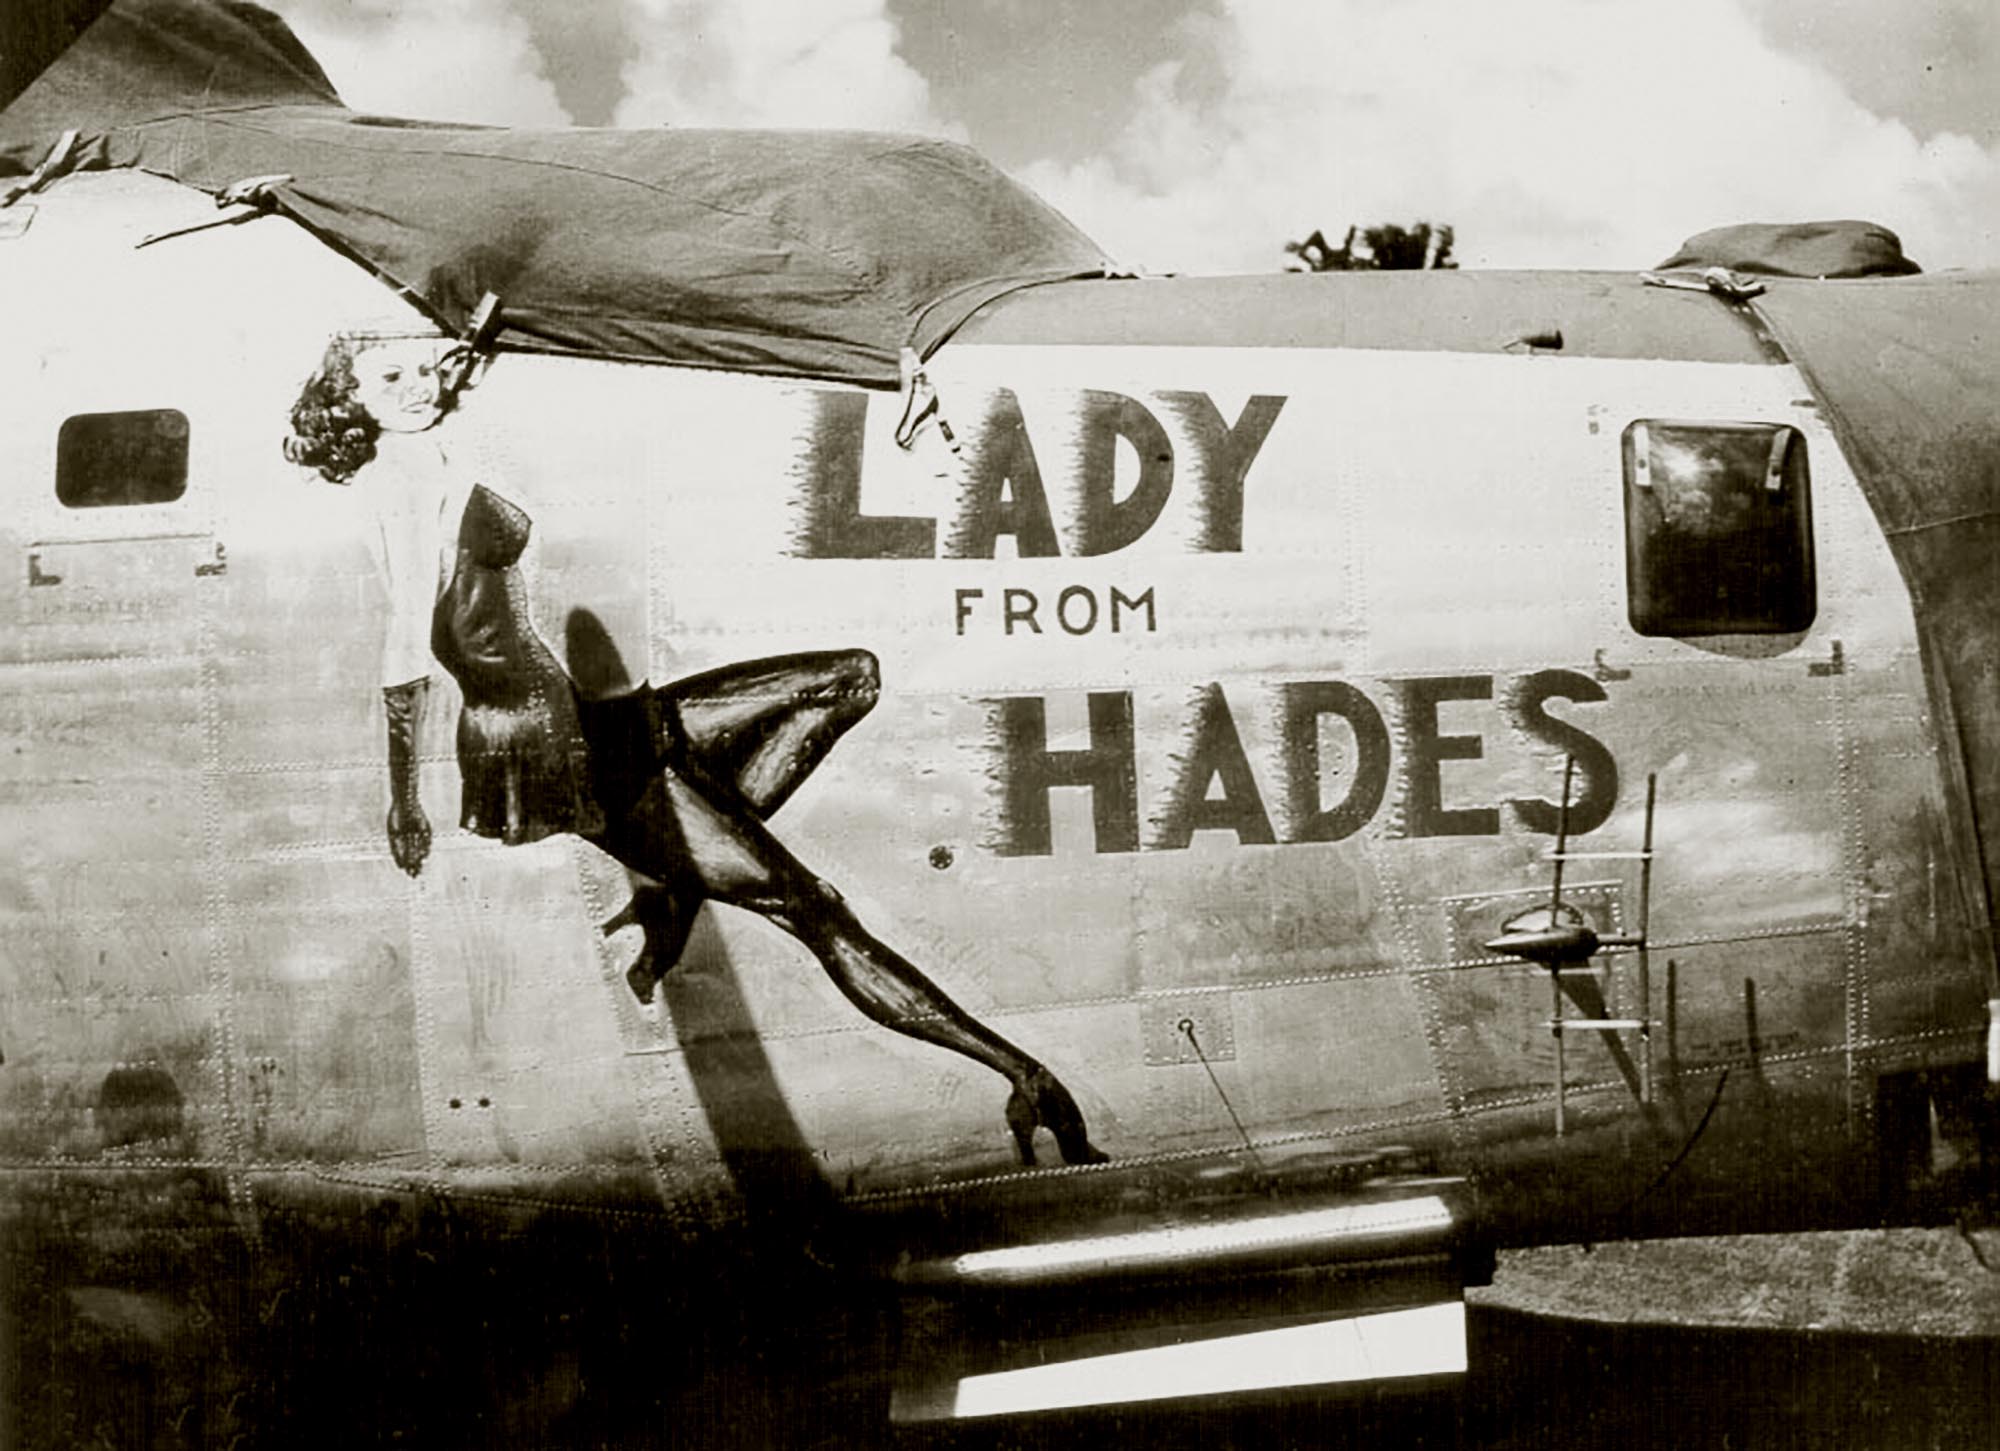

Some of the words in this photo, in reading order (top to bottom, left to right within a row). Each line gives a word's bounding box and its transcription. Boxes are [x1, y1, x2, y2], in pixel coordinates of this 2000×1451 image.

[780, 387, 1288, 559] LADY
[954, 585, 1157, 636] FROM
[974, 668, 1618, 857] HADES
